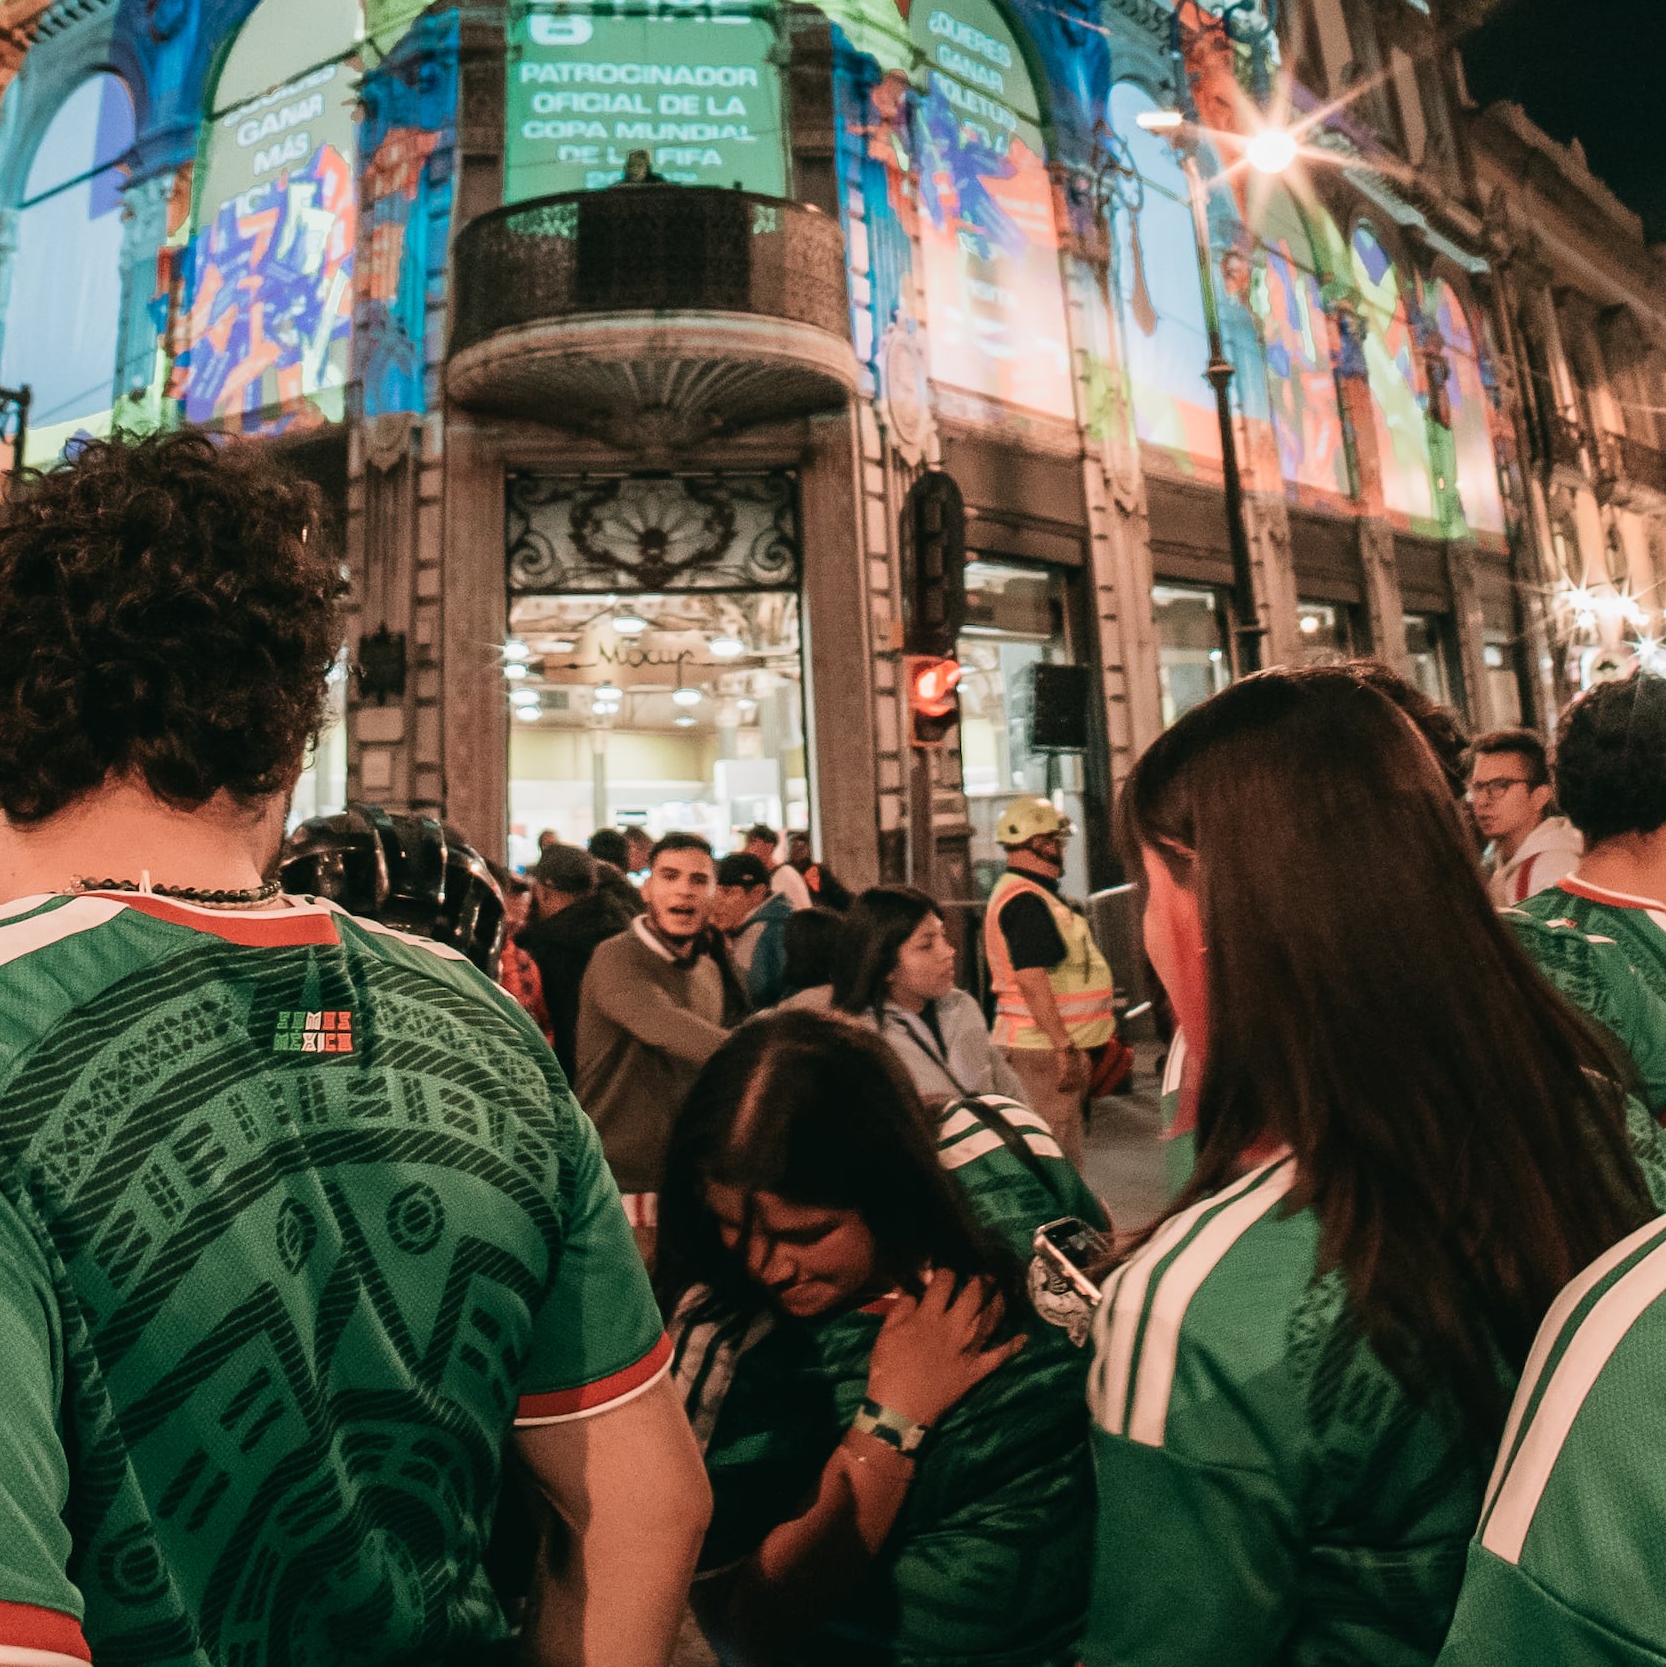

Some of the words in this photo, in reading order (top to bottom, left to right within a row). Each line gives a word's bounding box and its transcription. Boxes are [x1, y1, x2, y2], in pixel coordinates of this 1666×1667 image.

[519, 62, 758, 86] PATROCINADOR
[937, 43, 1003, 95] GANAR
[532, 91, 652, 114] OFICIAL
[657, 94, 701, 115] DE
[706, 96, 747, 116] LA
[236, 93, 325, 147] GANAR
[521, 119, 608, 138] COPA
[613, 121, 757, 142] MUNDIAL
[557, 144, 599, 165] DE
[654, 146, 722, 166] FIFA
